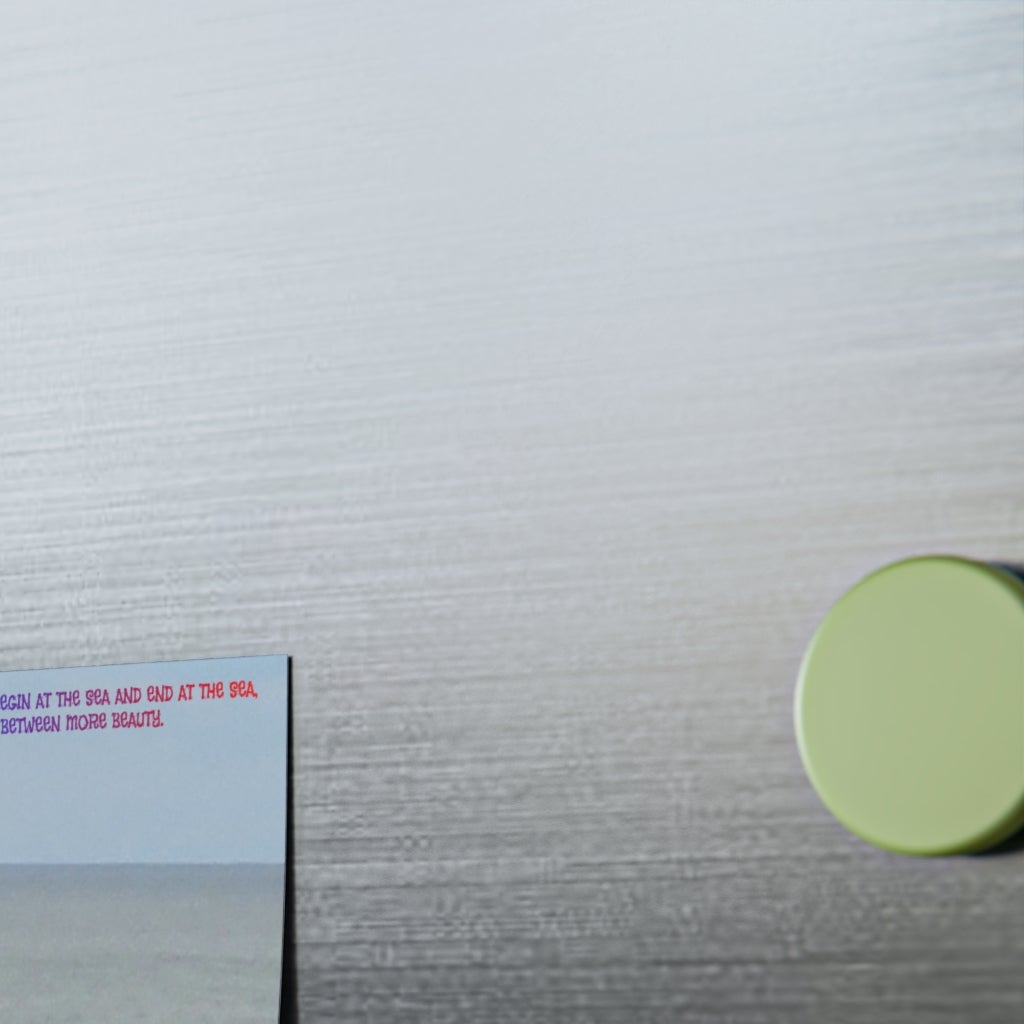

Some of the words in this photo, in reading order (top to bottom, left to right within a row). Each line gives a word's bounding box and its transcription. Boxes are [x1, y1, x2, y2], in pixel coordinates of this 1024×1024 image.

[35, 692, 53, 709] AT
[56, 689, 80, 707] THE
[85, 688, 111, 706] SEA
[114, 686, 142, 705] AND
[146, 685, 174, 702] END
[177, 683, 195, 702] AT
[199, 681, 224, 700] THE
[229, 680, 258, 699] SEA,
[0, 715, 61, 735] BETWEEN
[65, 712, 107, 731] MORE
[111, 709, 164, 729] BEAUTY.
